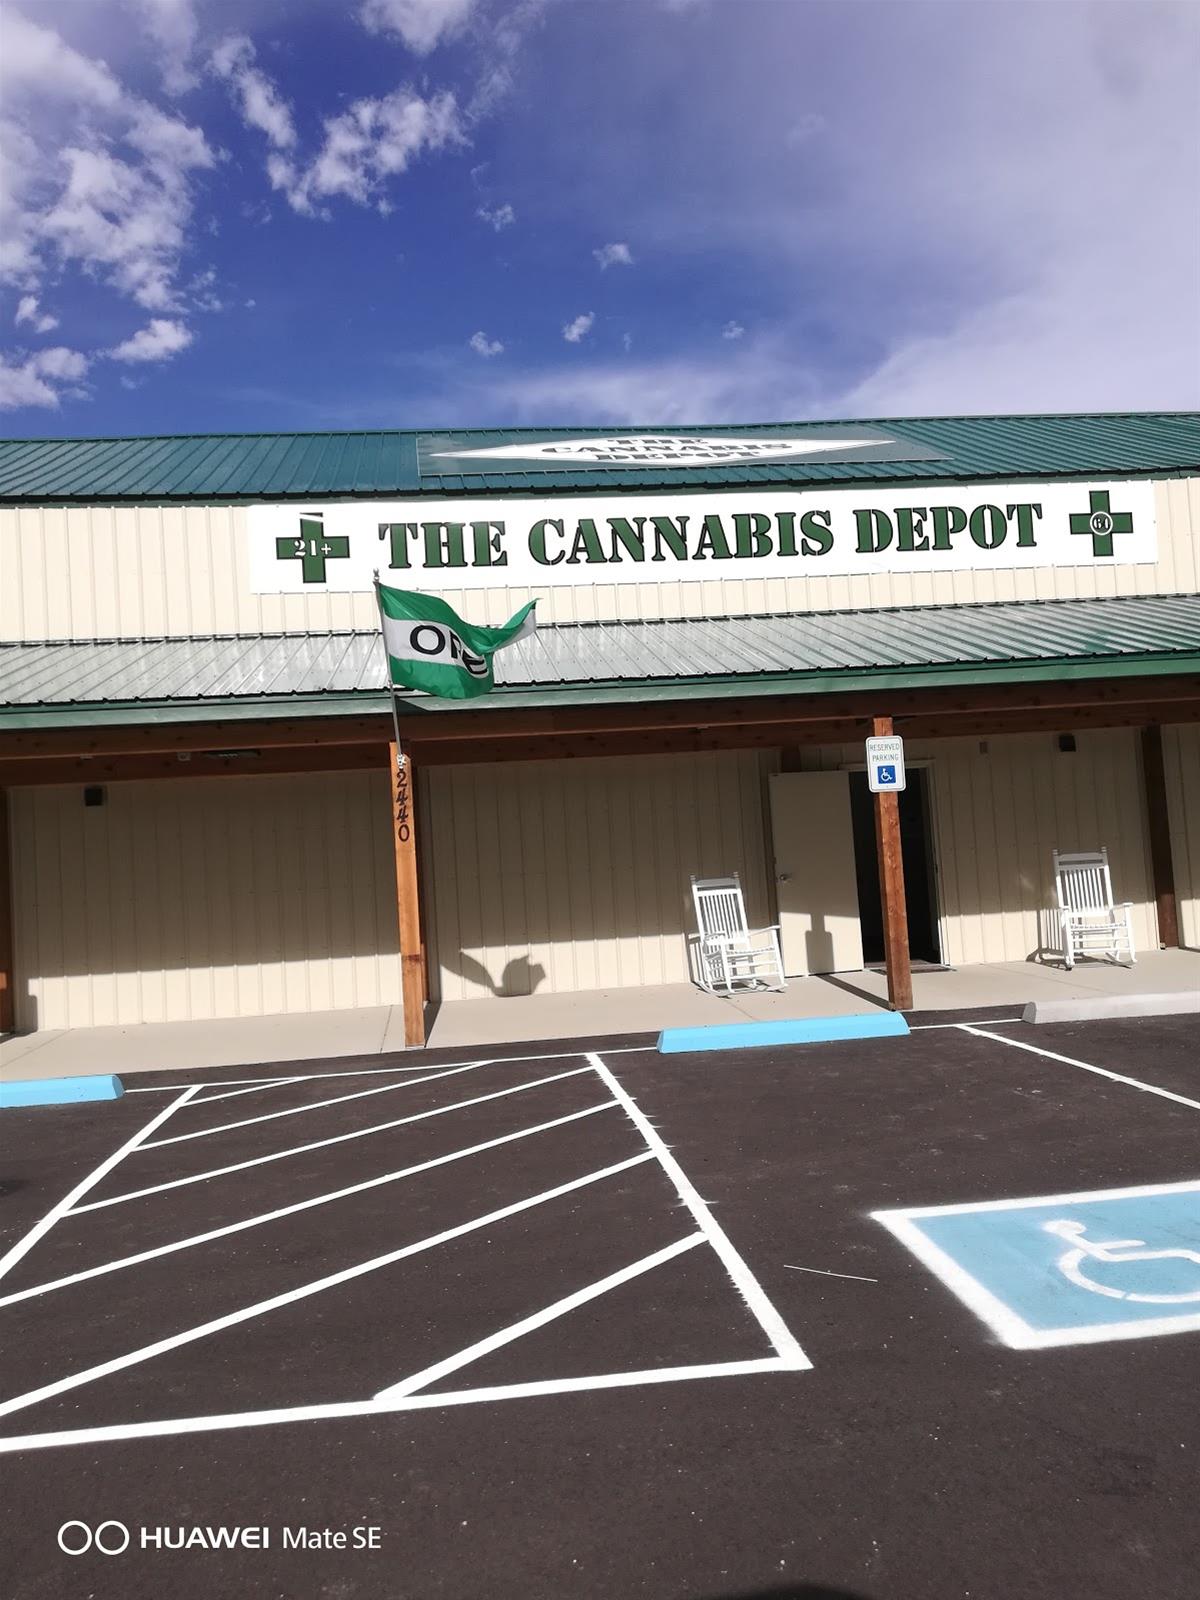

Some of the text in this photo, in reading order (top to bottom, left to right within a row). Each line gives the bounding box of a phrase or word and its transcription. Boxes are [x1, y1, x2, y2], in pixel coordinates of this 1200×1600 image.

[542, 443, 793, 453] CANNABIS
[595, 451, 760, 461] DEPOT
[379, 503, 1043, 569] THE CANNABIS DEPOT
[293, 539, 332, 557] 21+
[869, 743, 900, 751] RESERVED
[872, 754, 899, 762] PARKING
[396, 771, 410, 842] 2440
